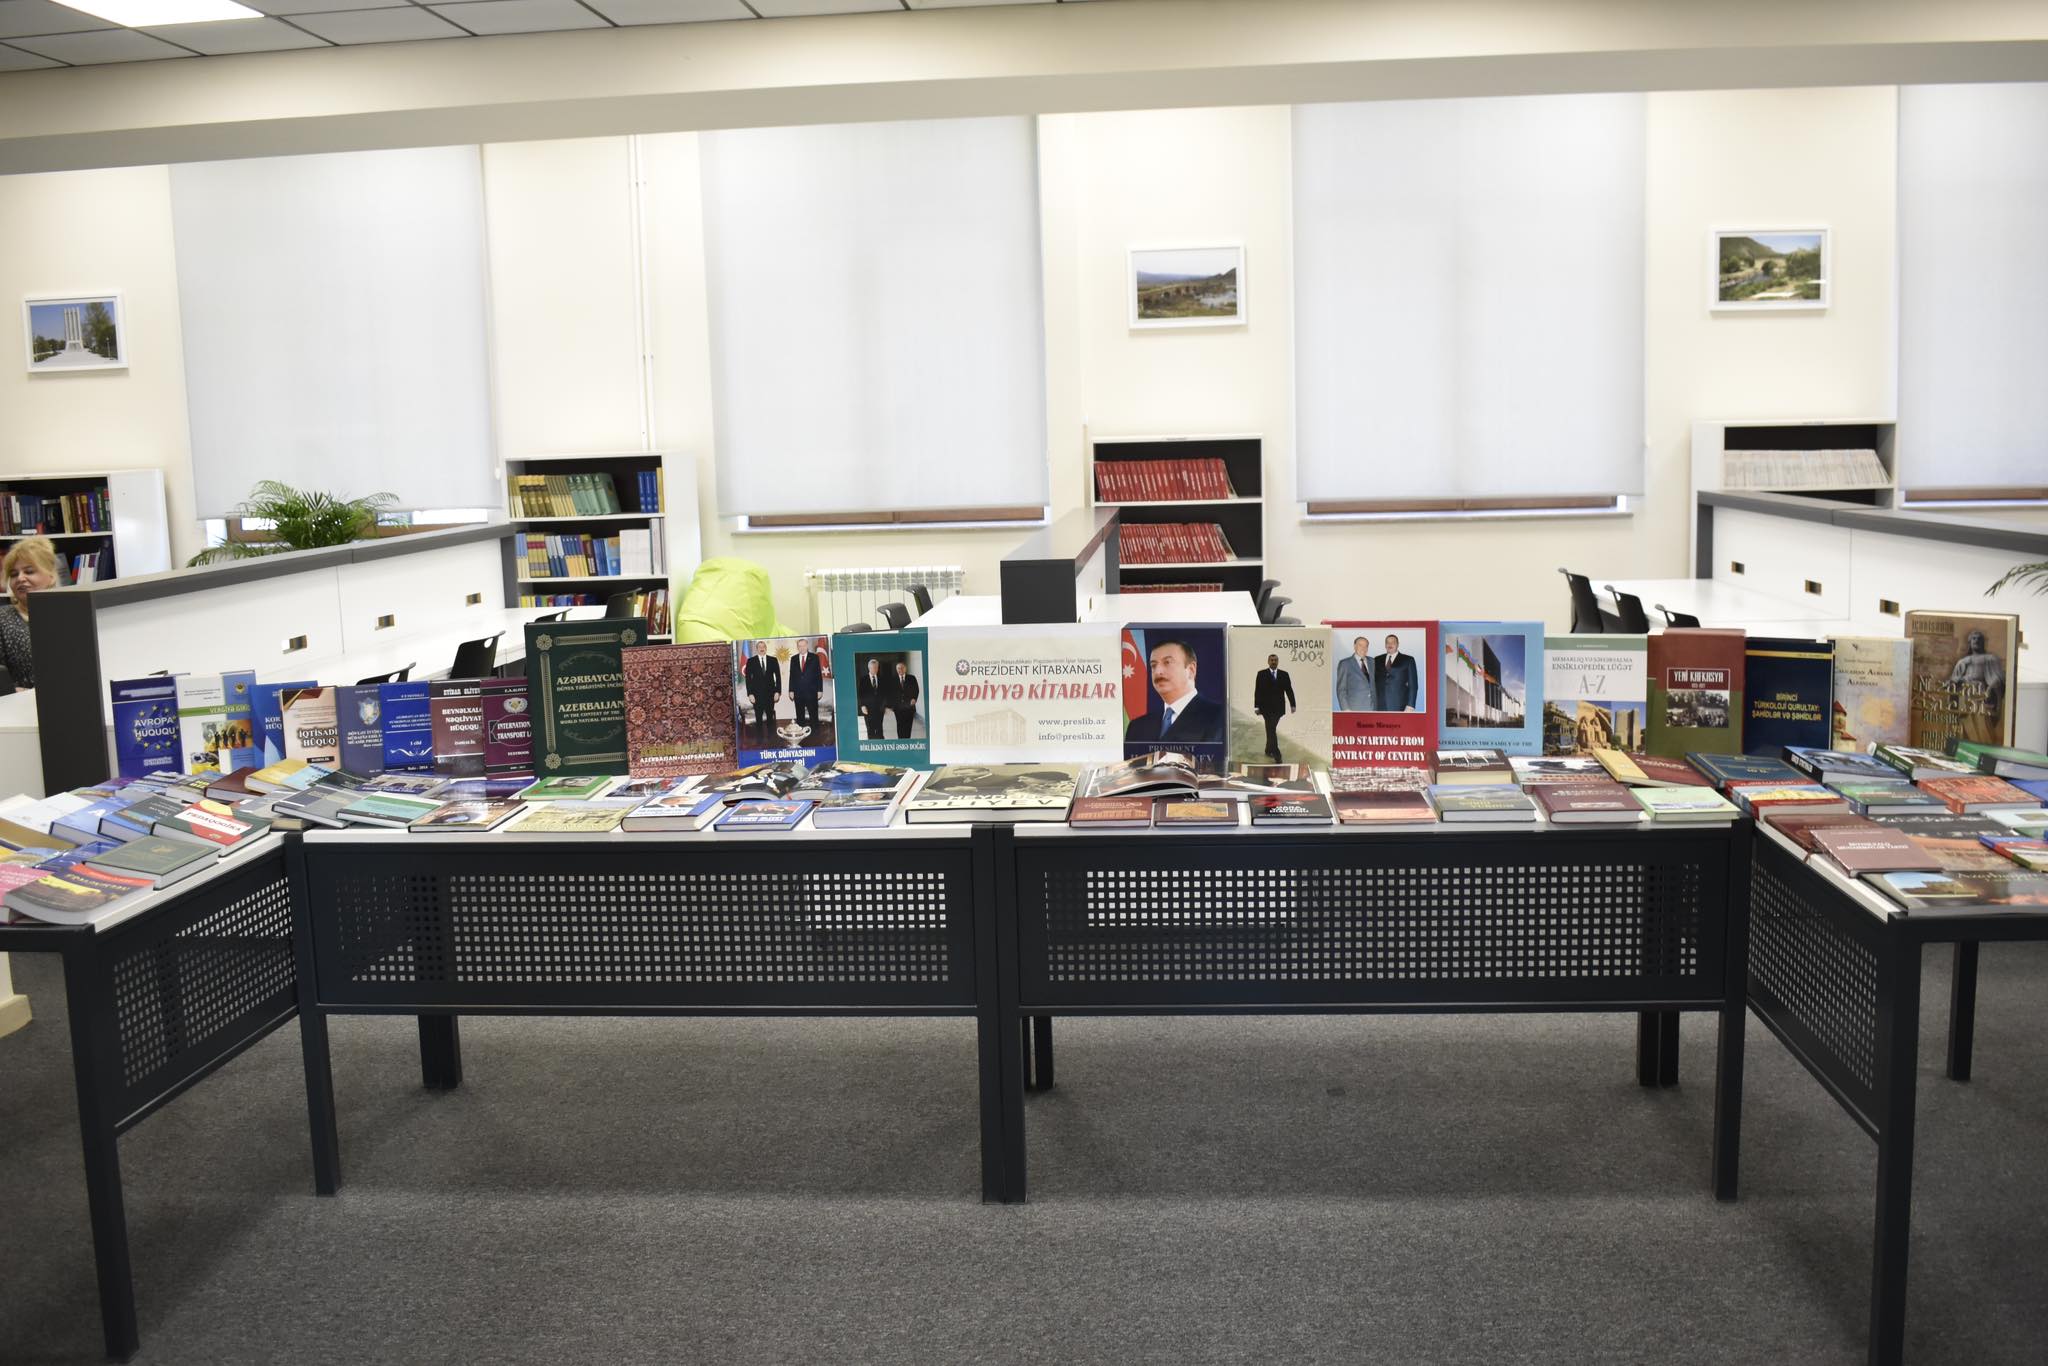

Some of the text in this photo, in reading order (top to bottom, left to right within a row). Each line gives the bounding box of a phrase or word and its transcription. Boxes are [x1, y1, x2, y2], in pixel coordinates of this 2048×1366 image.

[1273, 639, 1325, 649] AZƏRBAYCAN
[1290, 650, 1325, 667] 2003
[971, 662, 1103, 676] PREZİDENT KİTABXANASI
[1551, 662, 1633, 671] ENSİKLOPEDİK LÜĞƏT
[556, 672, 623, 685] AZƏRBAYCAN
[1673, 669, 1724, 683] YENİ KAFKASYA
[942, 678, 1117, 701] HƏDİYYƏ KİTABLAR
[558, 700, 624, 713] AZERBAIJAN
[1754, 700, 1787, 710] TÜRKOLOJİ
[133, 716, 175, 727] AVROPA
[450, 723, 479, 732] HÜQUQU
[497, 720, 531, 730] INTERNATION
[1038, 716, 1107, 727] www.preslib.az
[135, 725, 176, 739] HÜQUQU
[299, 727, 339, 739] İQTİSADİ
[497, 731, 527, 740] TRANSPORT
[1038, 731, 1106, 743] info@preslib.az
[303, 736, 336, 747] HÜQUQ
[883, 742, 896, 751] YENİ
[1332, 735, 1425, 747] ROAD STARTING FROM
[759, 748, 816, 760] TÜRK DÜNYASININ
[1148, 744, 1196, 752] PRESIDENT
[1374, 750, 1387, 761] OF
[1387, 751, 1426, 762] CENTURY
